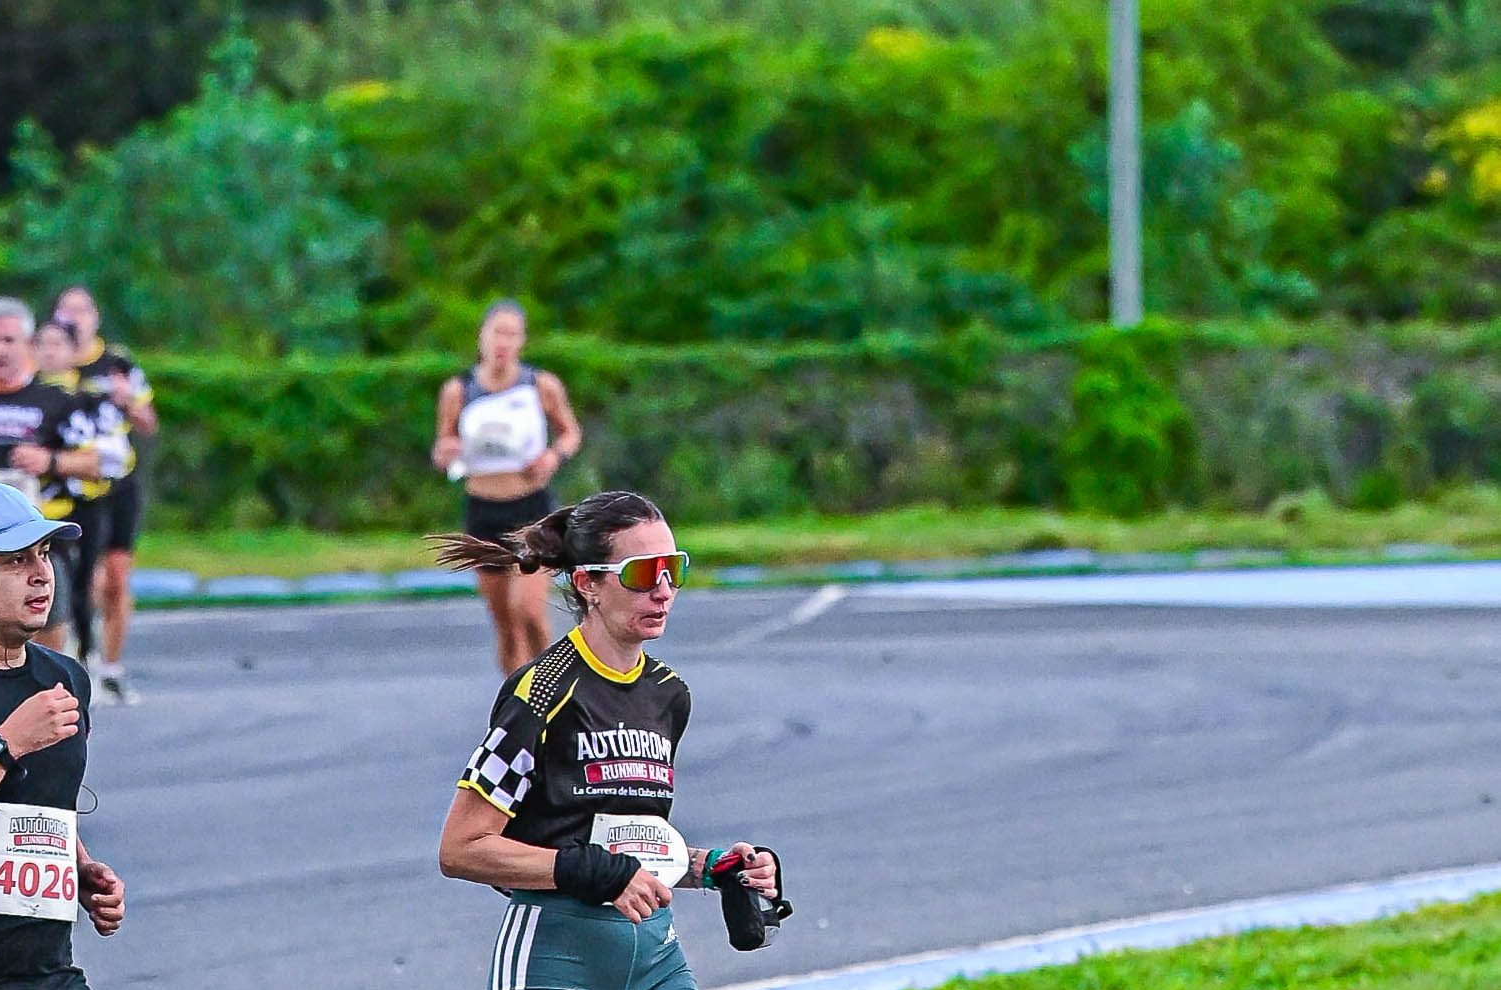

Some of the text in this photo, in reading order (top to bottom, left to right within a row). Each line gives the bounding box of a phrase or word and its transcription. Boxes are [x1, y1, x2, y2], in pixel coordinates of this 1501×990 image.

[576, 721, 672, 767] AUTÓDROM
[600, 762, 670, 785] RUNNING RACE
[572, 786, 584, 796] La
[585, 786, 617, 796] Carrera
[618, 786, 628, 796] de
